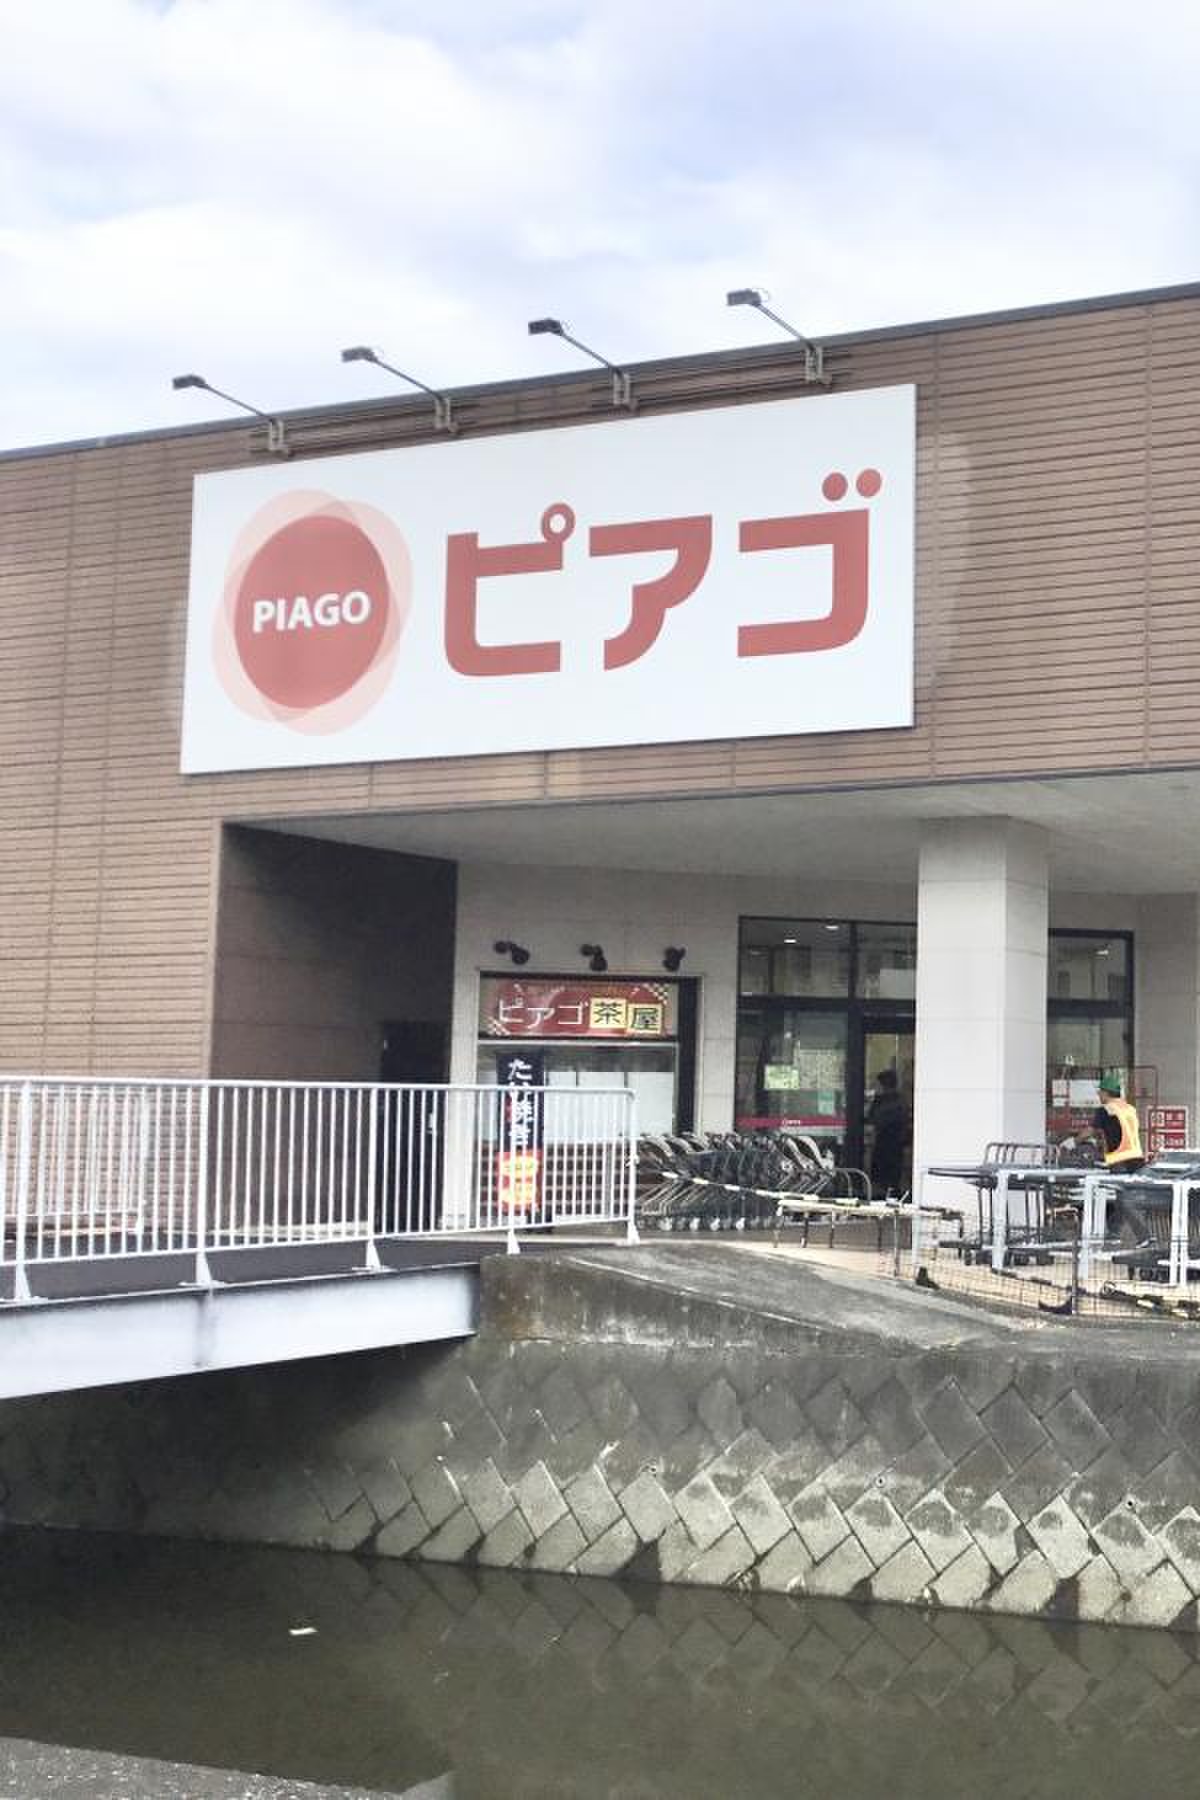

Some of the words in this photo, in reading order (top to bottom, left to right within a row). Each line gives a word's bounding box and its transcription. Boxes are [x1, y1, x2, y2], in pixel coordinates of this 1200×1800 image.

[444, 468, 882, 677] ピアゴ
[253, 591, 371, 633] PIAGO
[500, 996, 661, 1032] ピアゴ茶屋
